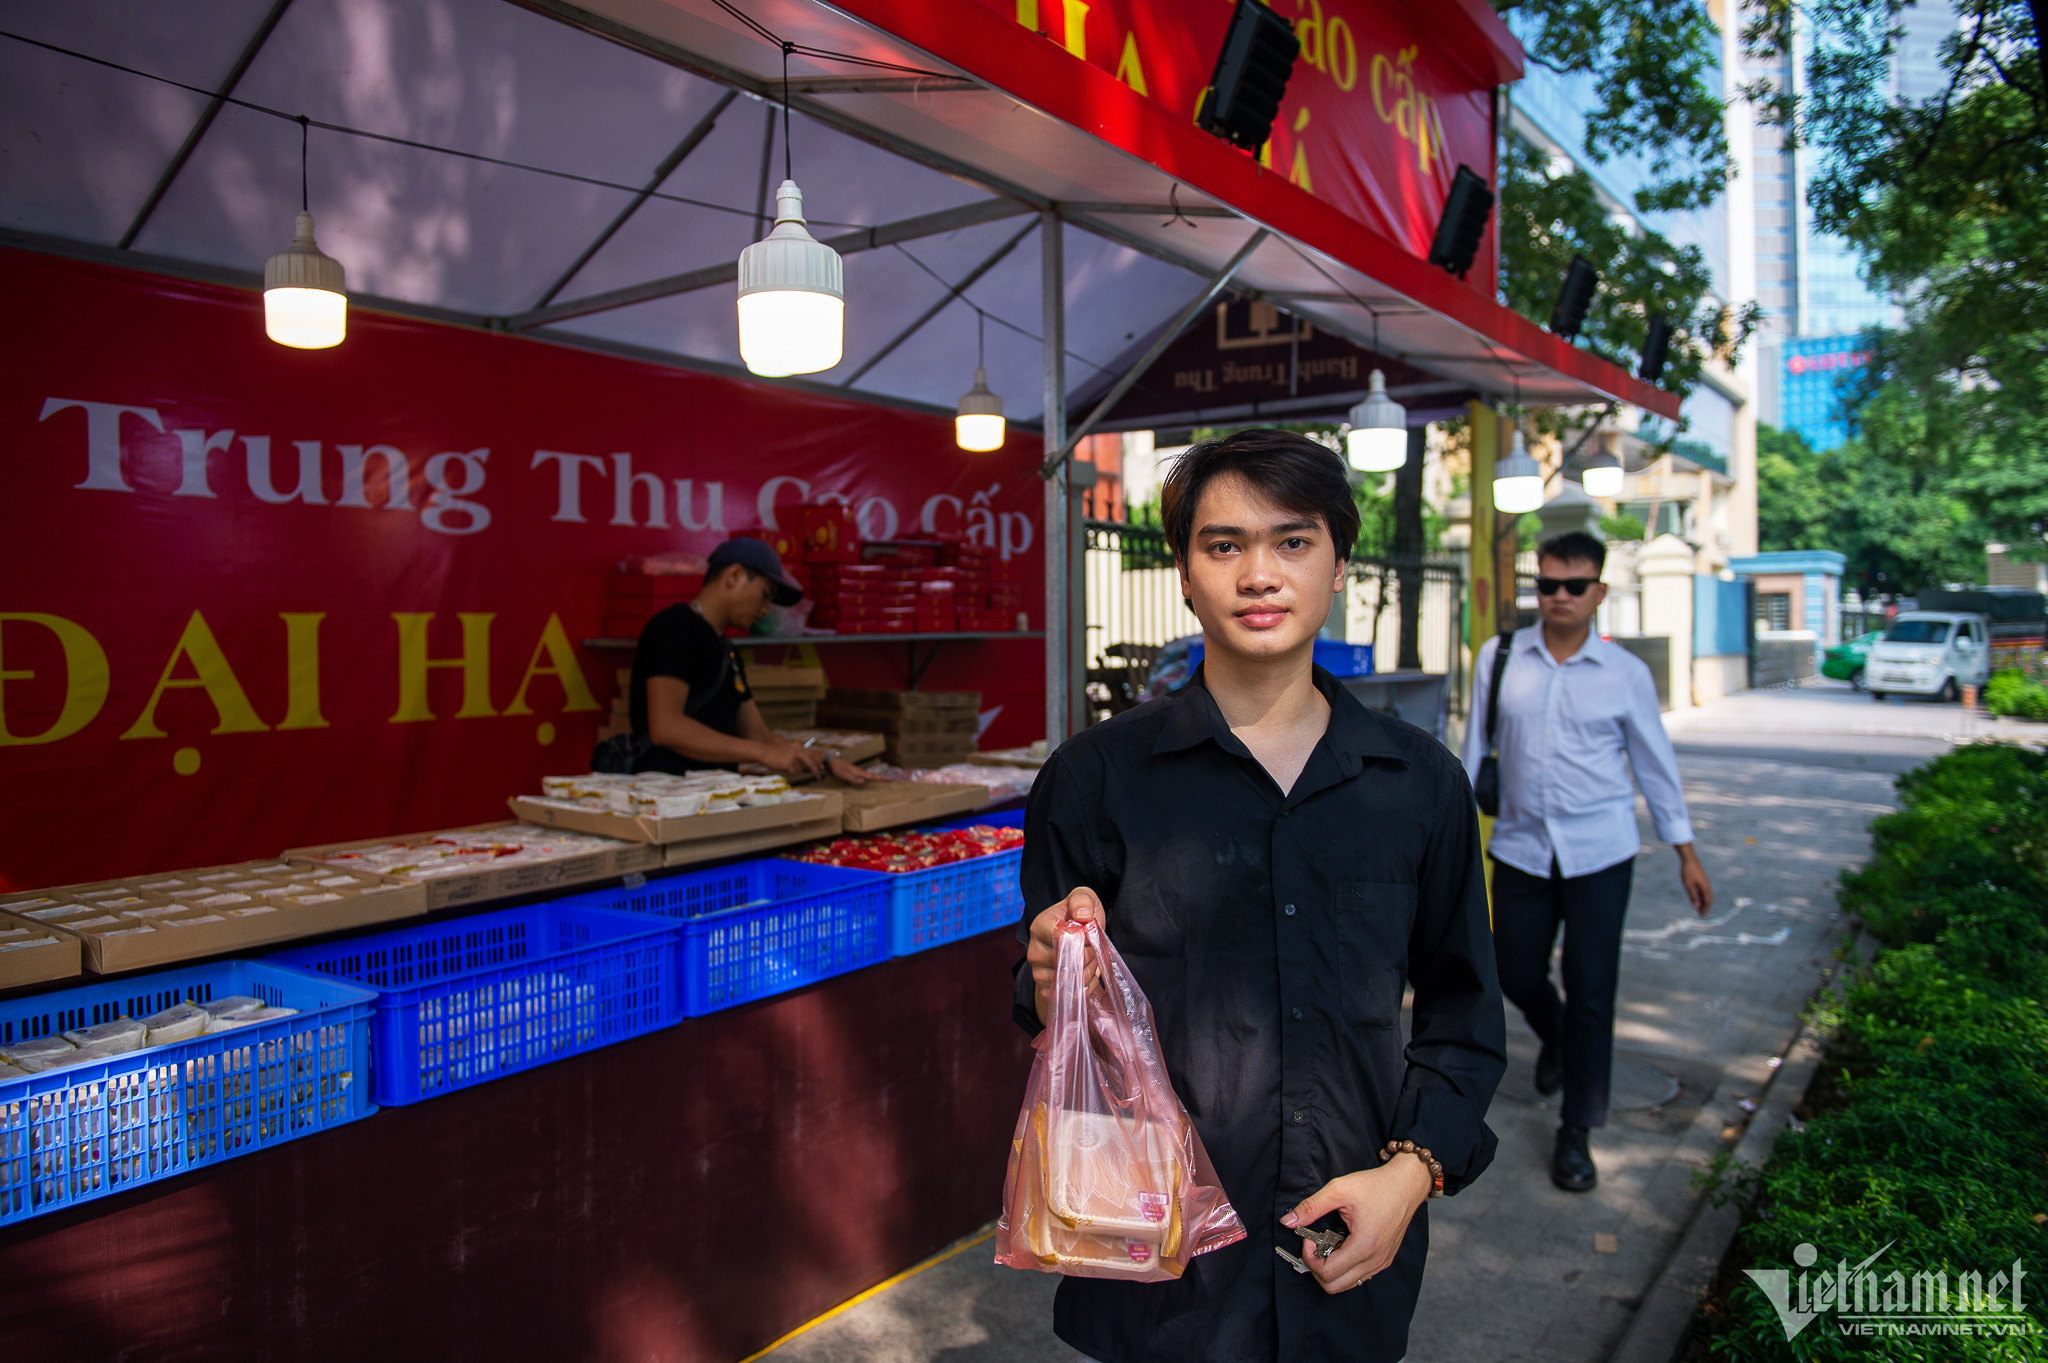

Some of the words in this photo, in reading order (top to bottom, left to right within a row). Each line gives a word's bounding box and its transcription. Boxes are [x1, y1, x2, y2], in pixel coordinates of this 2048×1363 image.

[1174, 369, 1219, 393] Thu
[1221, 361, 1290, 386] Trung
[39, 397, 491, 535] Trung
[529, 449, 728, 533] Thu
[757, 475, 899, 543] Co
[920, 482, 1035, 560] Cấp
[0, 608, 331, 777] ĐẠI
[387, 611, 602, 747] HẠ
